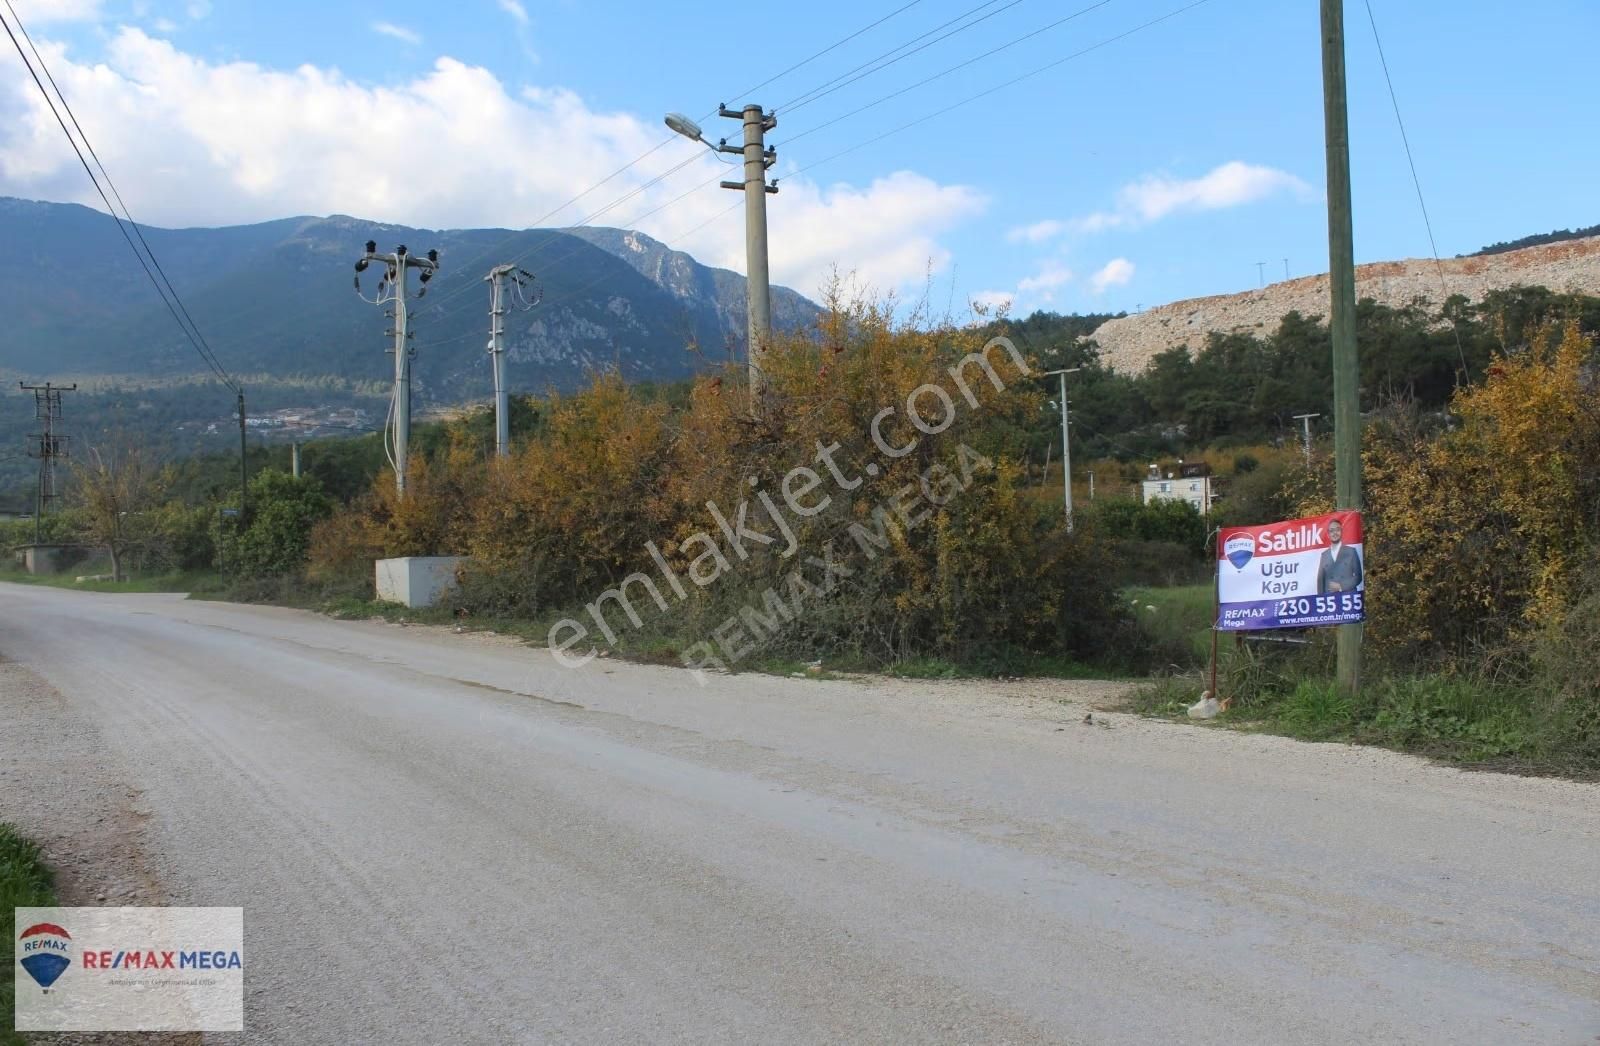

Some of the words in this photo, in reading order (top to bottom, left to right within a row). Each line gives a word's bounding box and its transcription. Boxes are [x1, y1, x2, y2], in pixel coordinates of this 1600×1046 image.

[1258, 523, 1324, 553] Satılık
[1261, 561, 1300, 578] Uğur
[1261, 581, 1298, 595] Kaya
[1278, 598, 1310, 616] 230
[1316, 596, 1337, 613] 55
[1342, 594, 1362, 611] 55
[1225, 608, 1265, 619] RE/MAX
[1223, 619, 1245, 627] Mega
